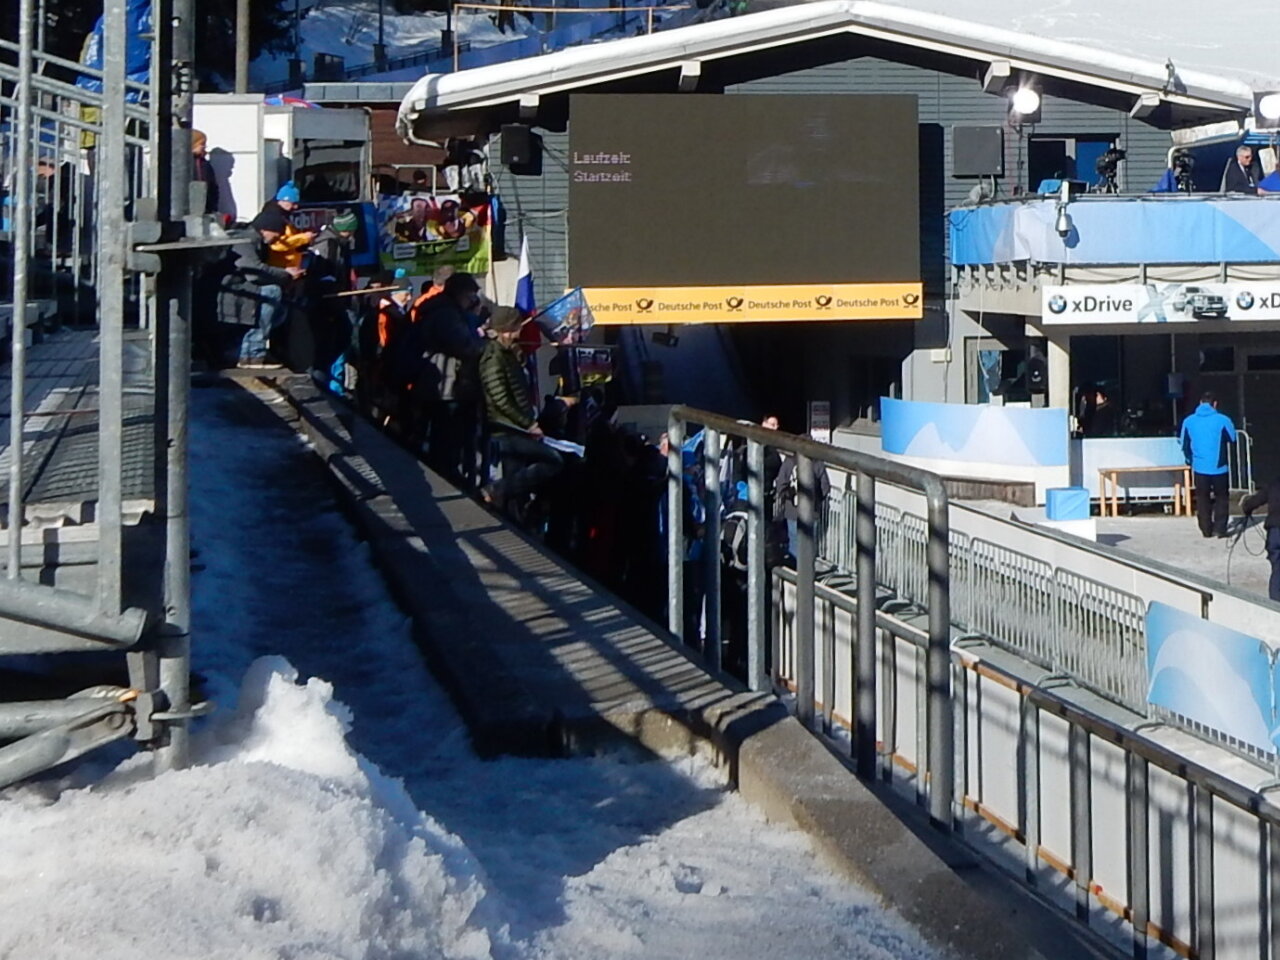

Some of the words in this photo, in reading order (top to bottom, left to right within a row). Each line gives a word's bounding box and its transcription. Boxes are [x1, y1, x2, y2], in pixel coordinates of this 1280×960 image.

[612, 303, 633, 312] Post
[658, 302, 701, 312] Deutsche
[703, 301, 723, 310] Post
[748, 300, 791, 309] Deutsche
[793, 299, 812, 309] Post
[836, 298, 878, 307] Deutsche
[880, 298, 899, 307] Post
[1072, 296, 1133, 313] xDrive
